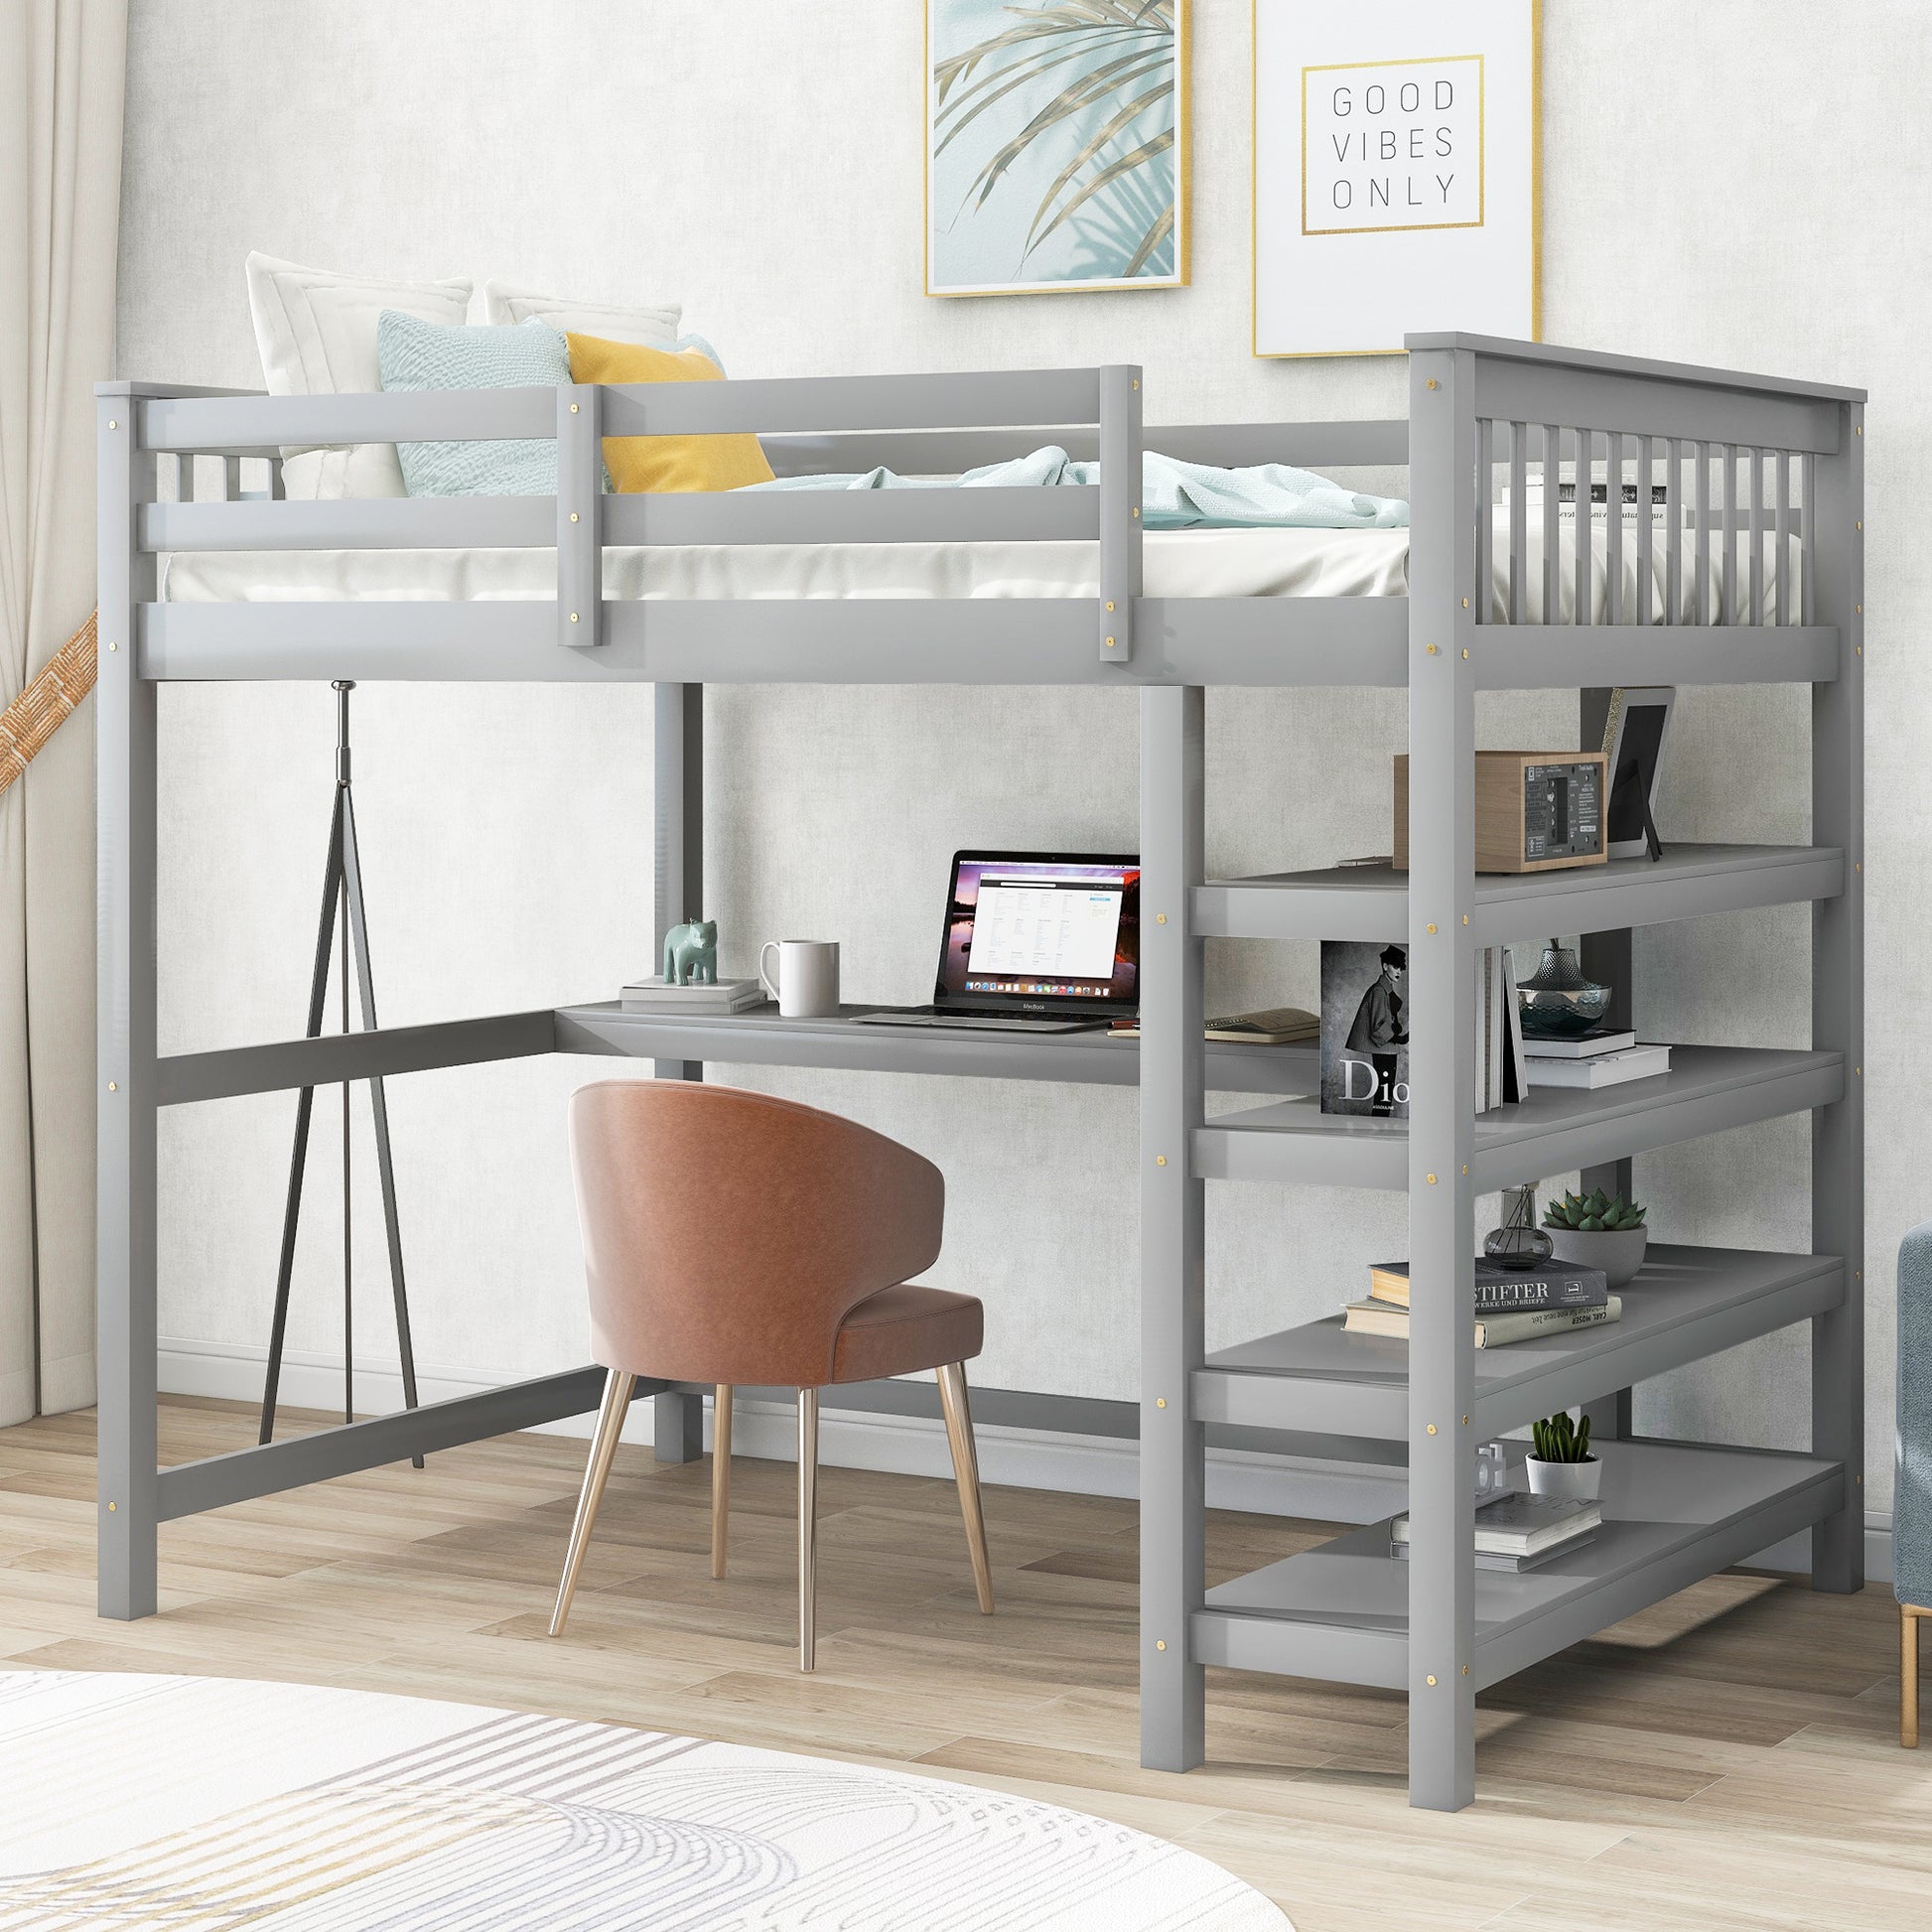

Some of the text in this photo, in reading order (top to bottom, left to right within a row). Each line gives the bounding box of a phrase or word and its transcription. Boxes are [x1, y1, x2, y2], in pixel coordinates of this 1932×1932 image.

[1332, 79, 1454, 117] GOOD
[1331, 126, 1453, 163] VIBES
[1332, 174, 1454, 209] ONLY
